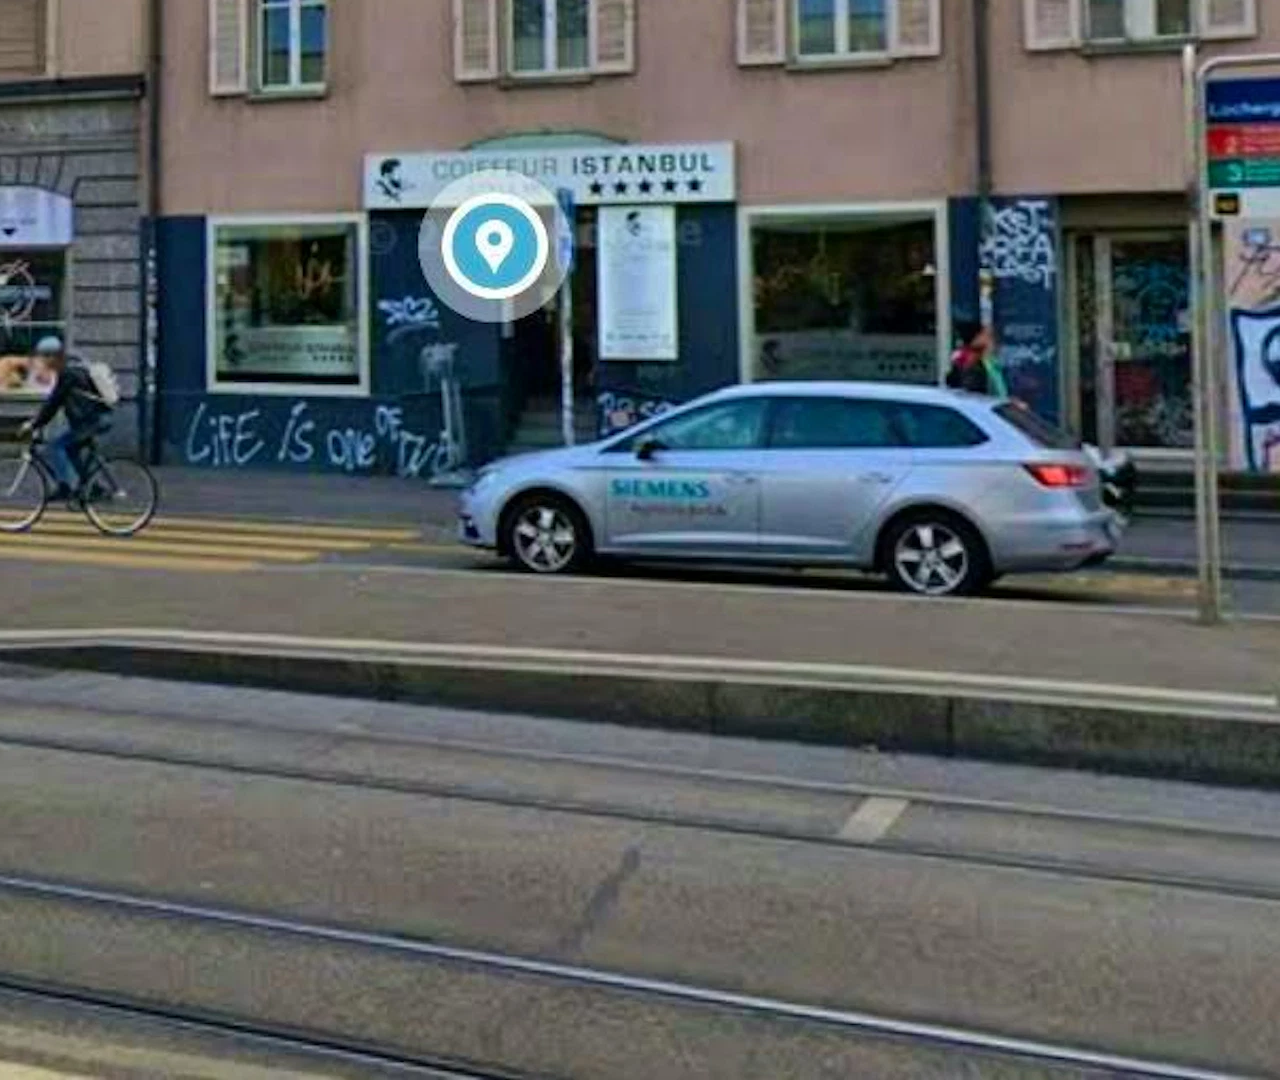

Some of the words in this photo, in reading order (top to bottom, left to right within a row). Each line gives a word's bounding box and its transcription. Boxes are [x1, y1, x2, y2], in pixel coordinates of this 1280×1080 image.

[431, 156, 559, 180] COIFFEUR
[572, 152, 715, 176] ISTANBUL
[1227, 162, 1244, 182] 3
[610, 478, 710, 498] SIEMENS
